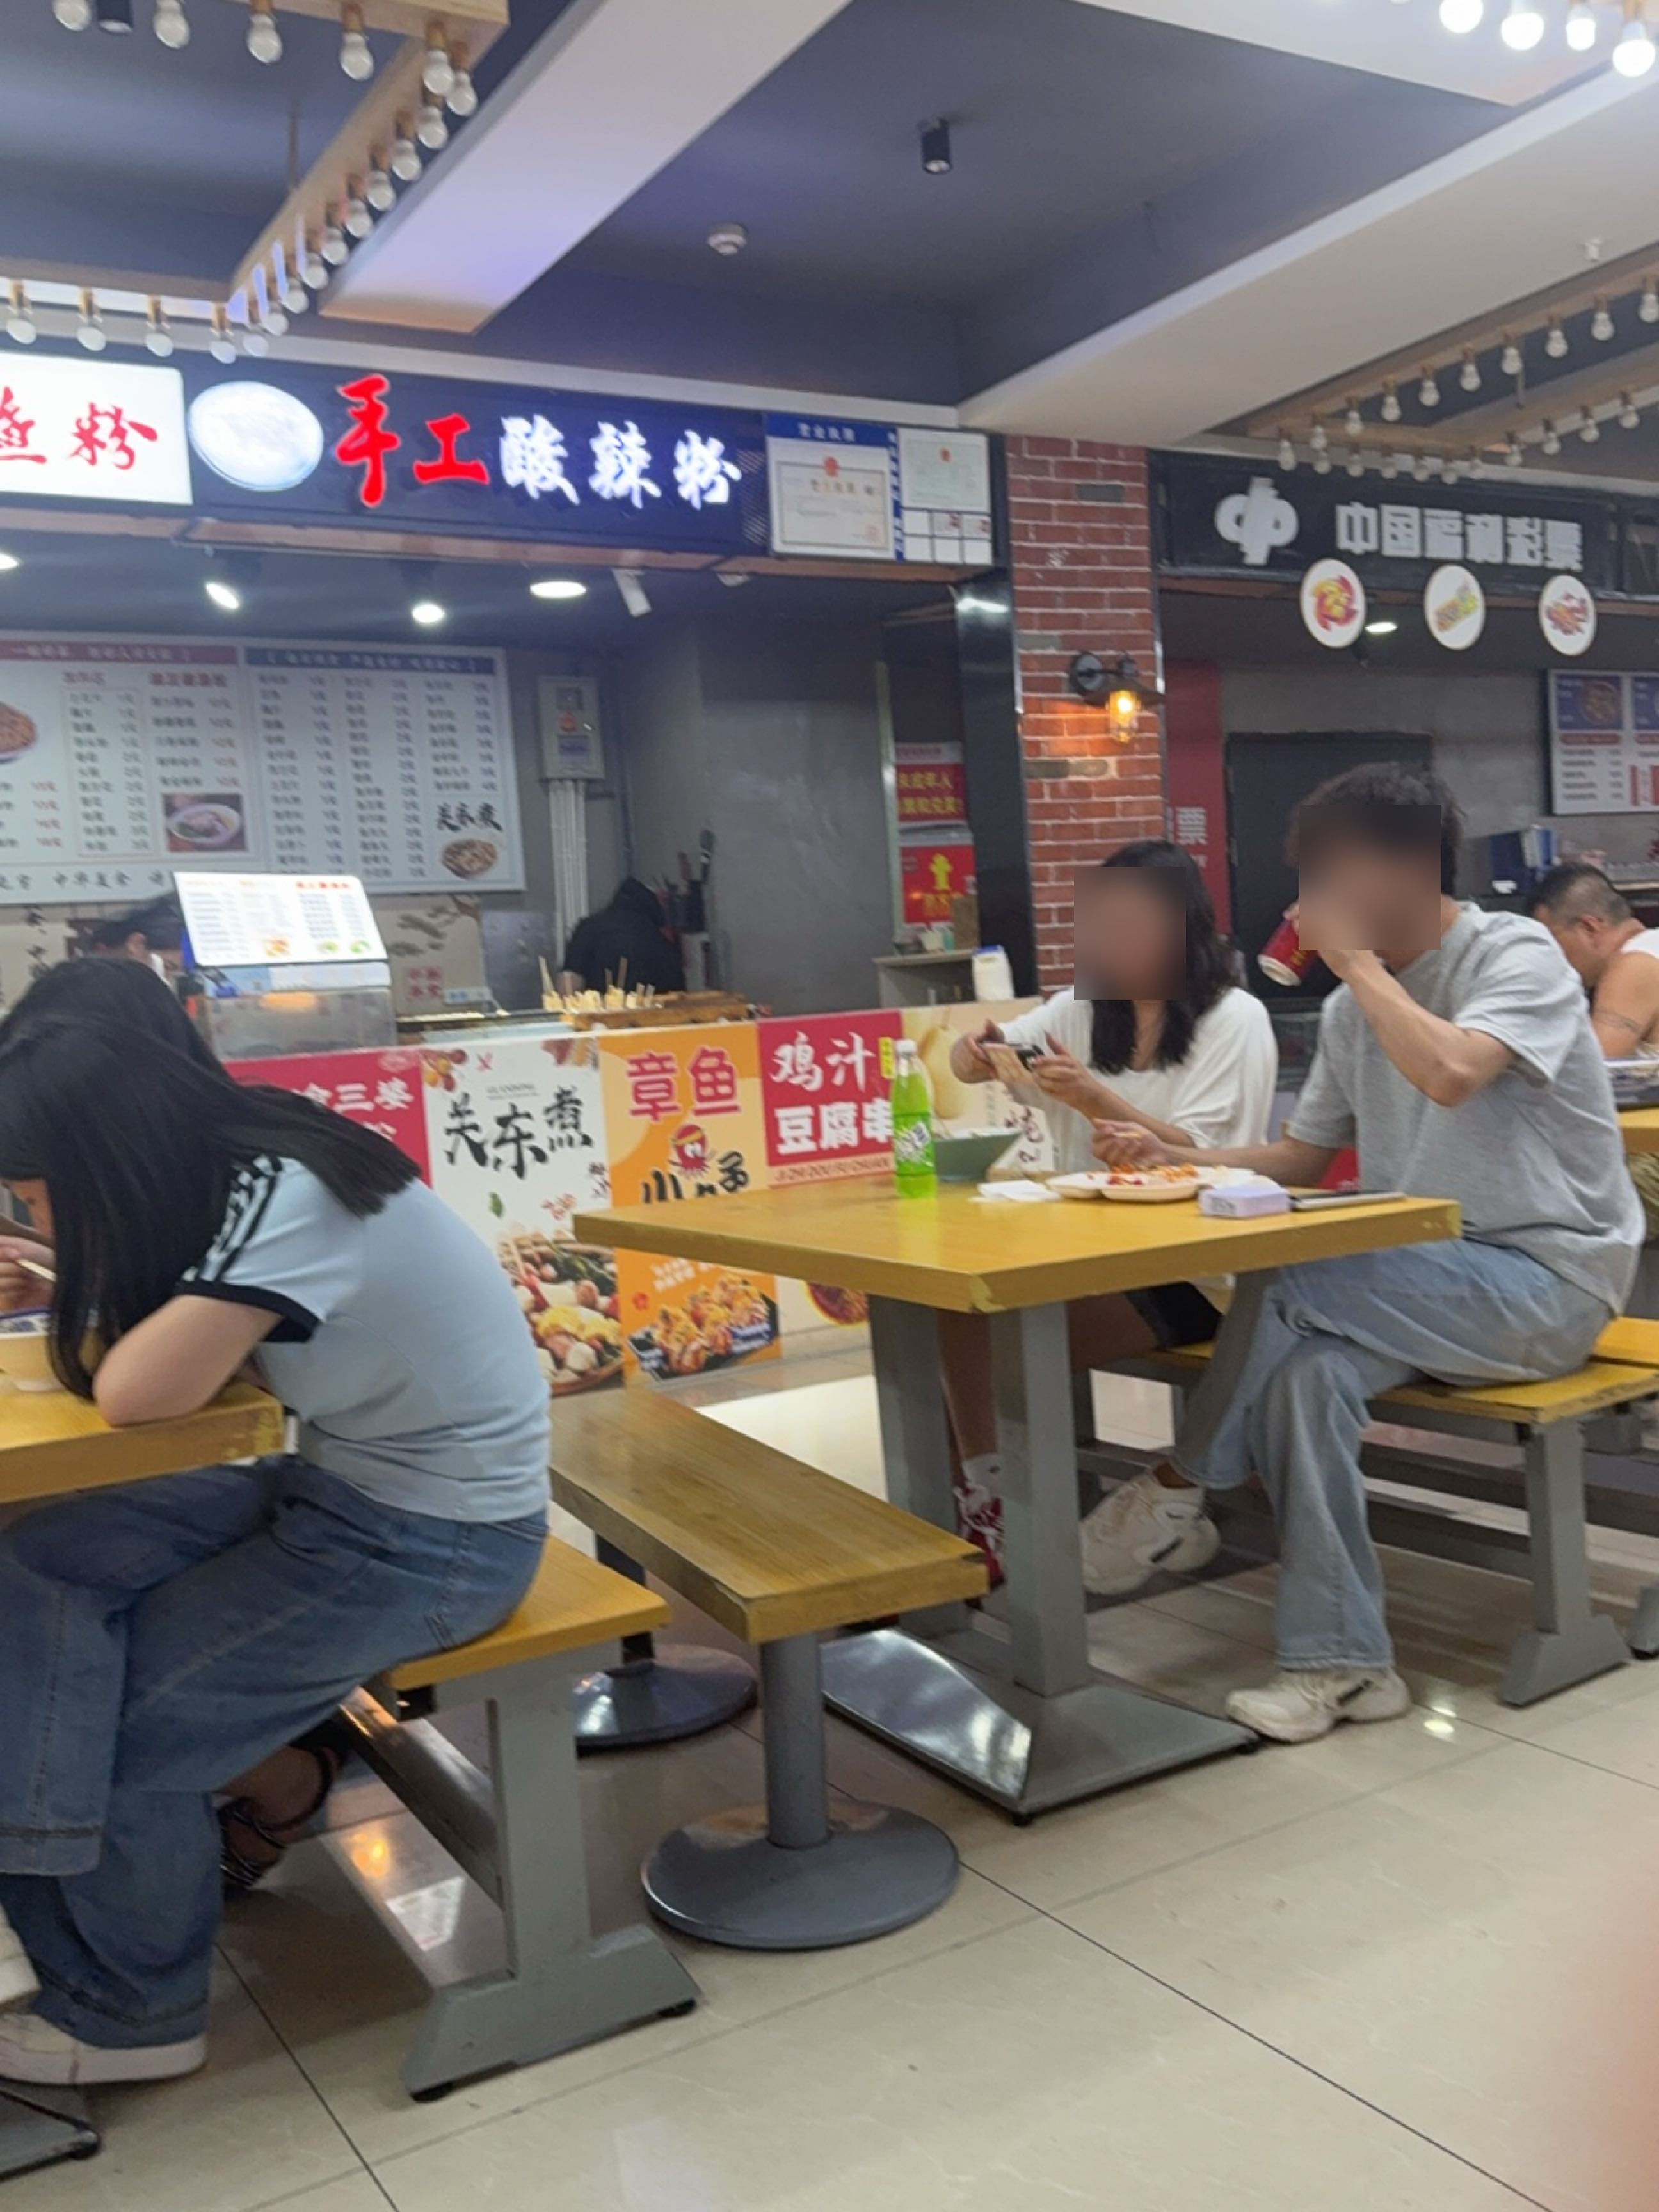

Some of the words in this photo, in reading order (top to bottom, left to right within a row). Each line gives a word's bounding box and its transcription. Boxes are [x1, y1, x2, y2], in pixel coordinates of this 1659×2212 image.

[625, 1045, 741, 1121] 章鱼
[770, 1030, 876, 1092] 鸡汁
[443, 1084, 594, 1180] 关东煮
[774, 1097, 894, 1155] 豆腐串
